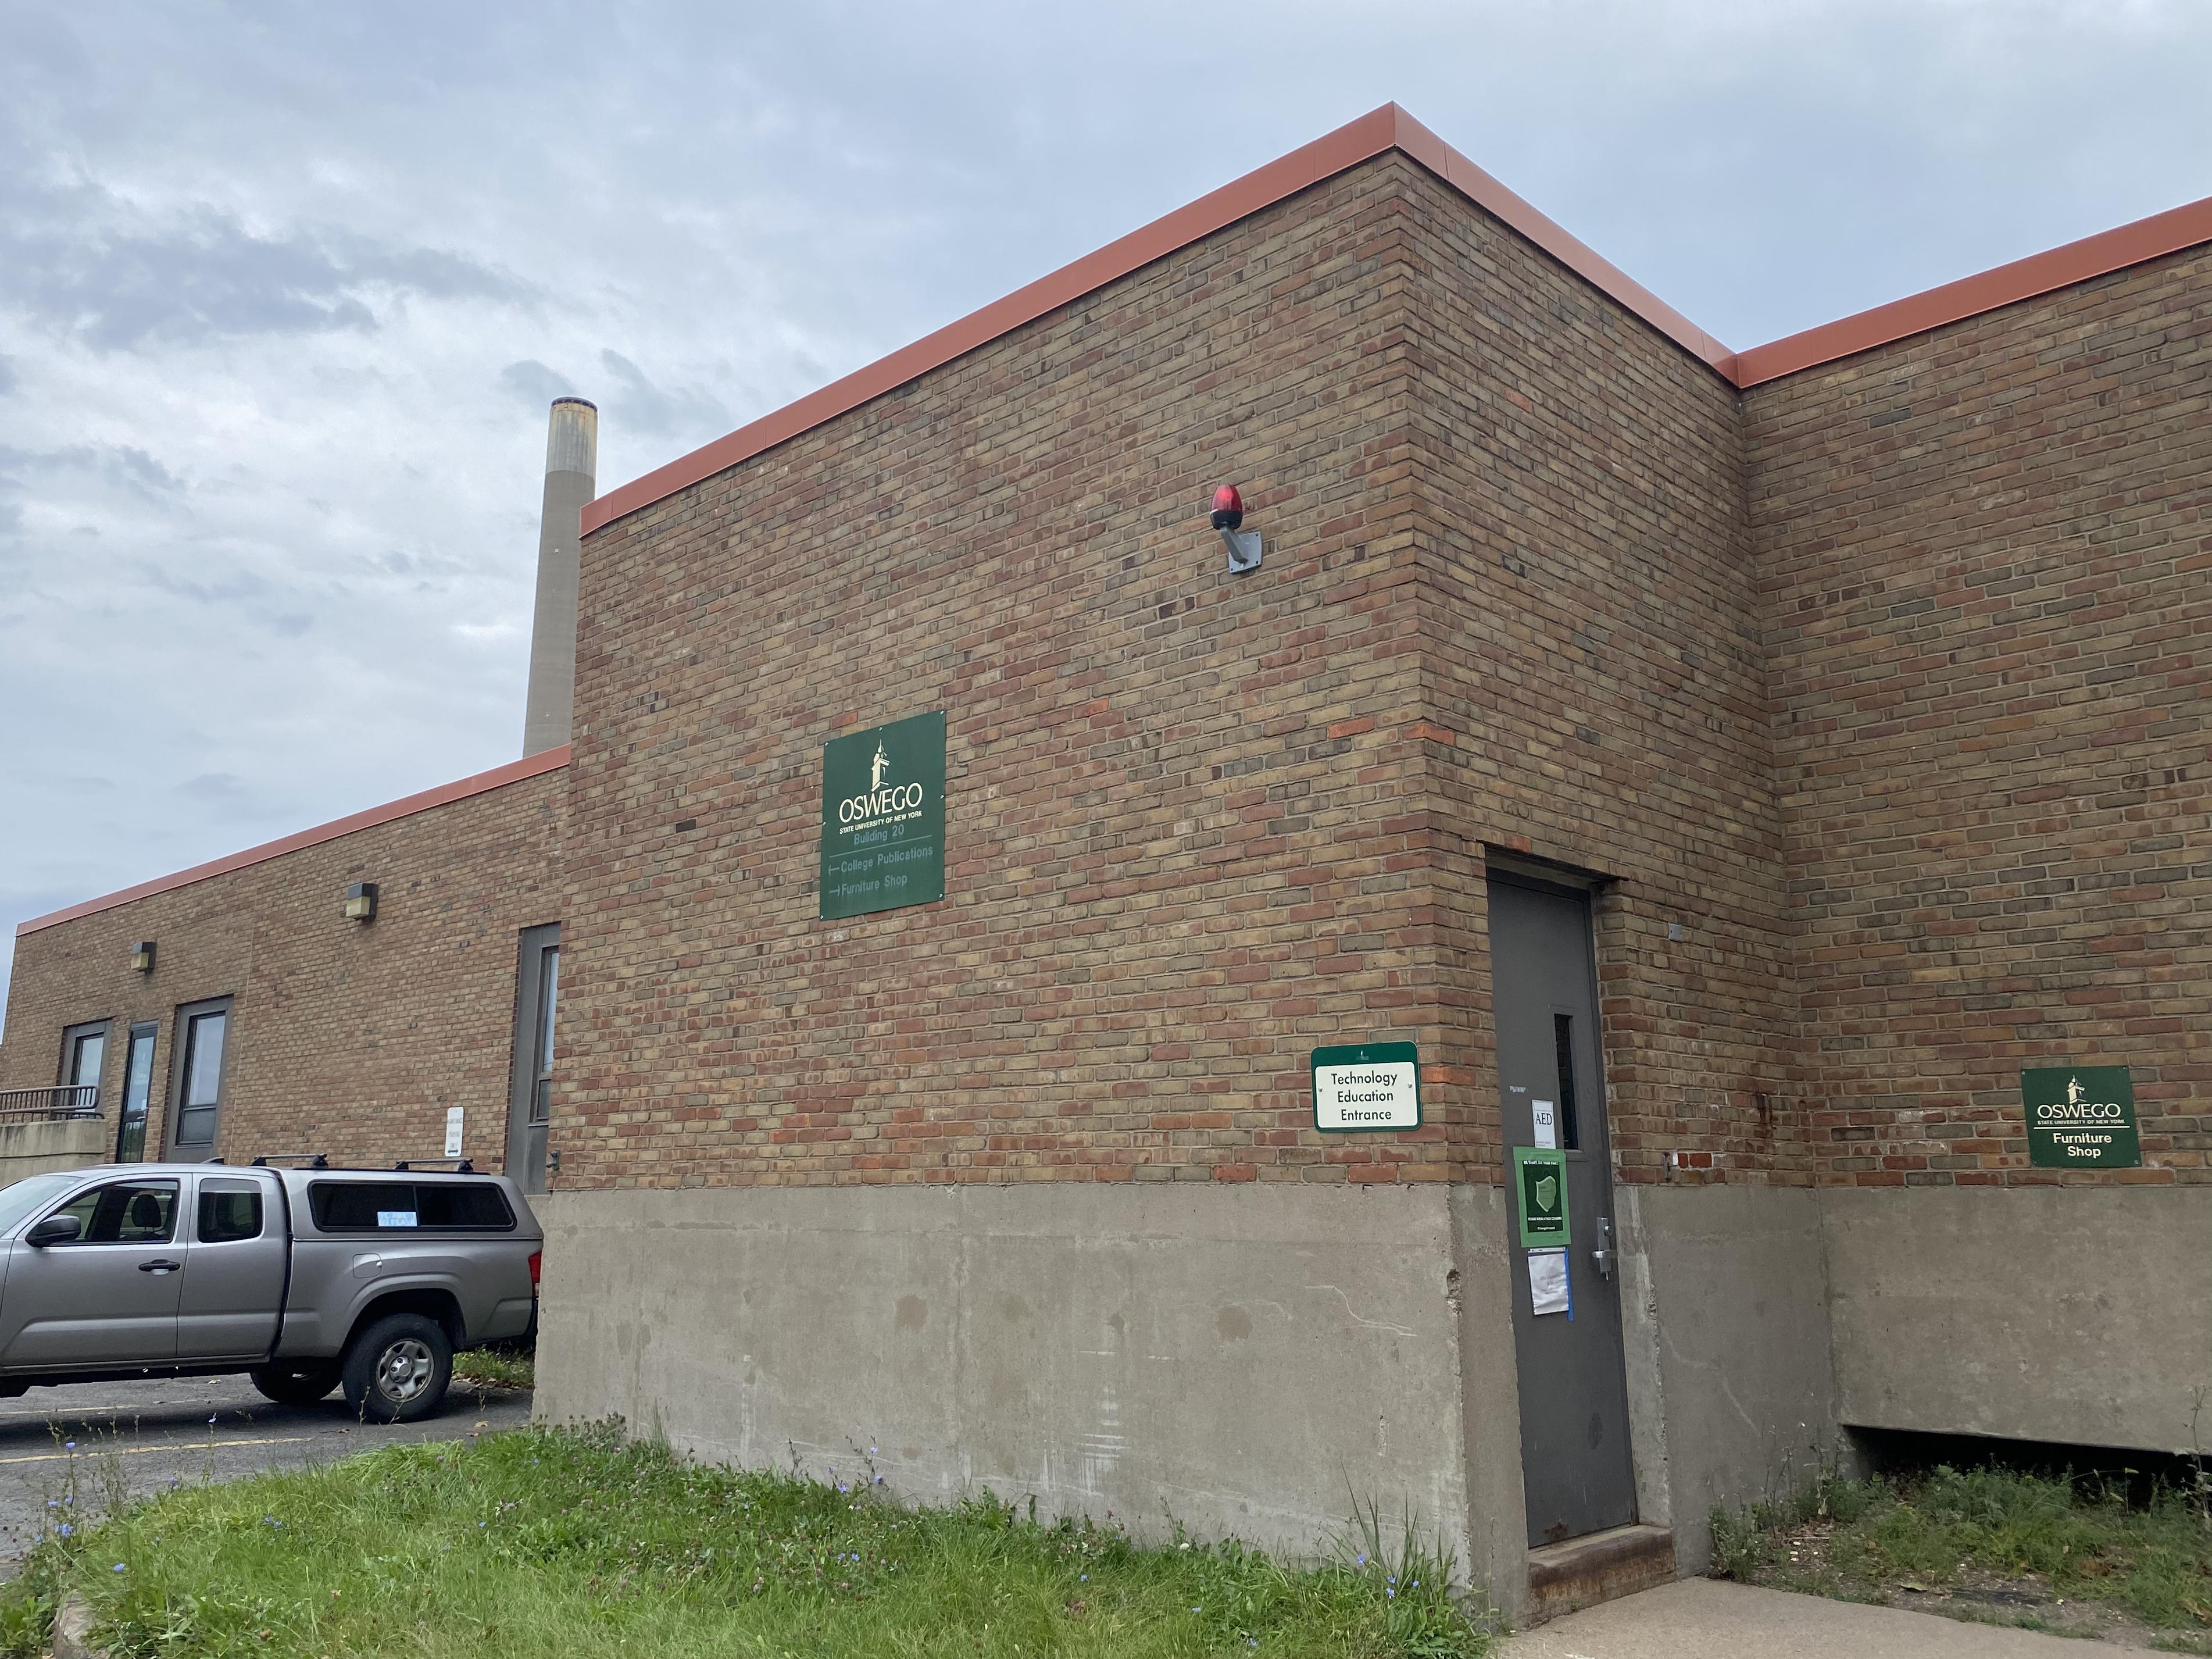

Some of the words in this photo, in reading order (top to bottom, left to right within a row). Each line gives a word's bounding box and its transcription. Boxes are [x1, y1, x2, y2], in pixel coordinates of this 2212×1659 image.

[839, 782, 923, 823] OSWEGO
[839, 826, 855, 834] STATE
[855, 818, 885, 831] UNIVERSITY
[894, 814, 907, 823] NEW
[908, 810, 923, 819] YORK
[854, 829, 888, 845] Building
[892, 824, 905, 838] 20
[841, 855, 873, 872] College
[877, 845, 933, 866] Publications
[841, 880, 880, 896] Furniture
[885, 874, 907, 888] Shop
[1331, 1070, 1398, 1086] Technology
[1338, 1089, 1393, 1103] Education
[1341, 1109, 1392, 1121] Entrance
[1535, 1112, 1553, 1125] AED
[2037, 1103, 2121, 1119] OSWEGO
[2053, 1133, 2112, 1144] Furniture
[2067, 1146, 2102, 1159] Shop
